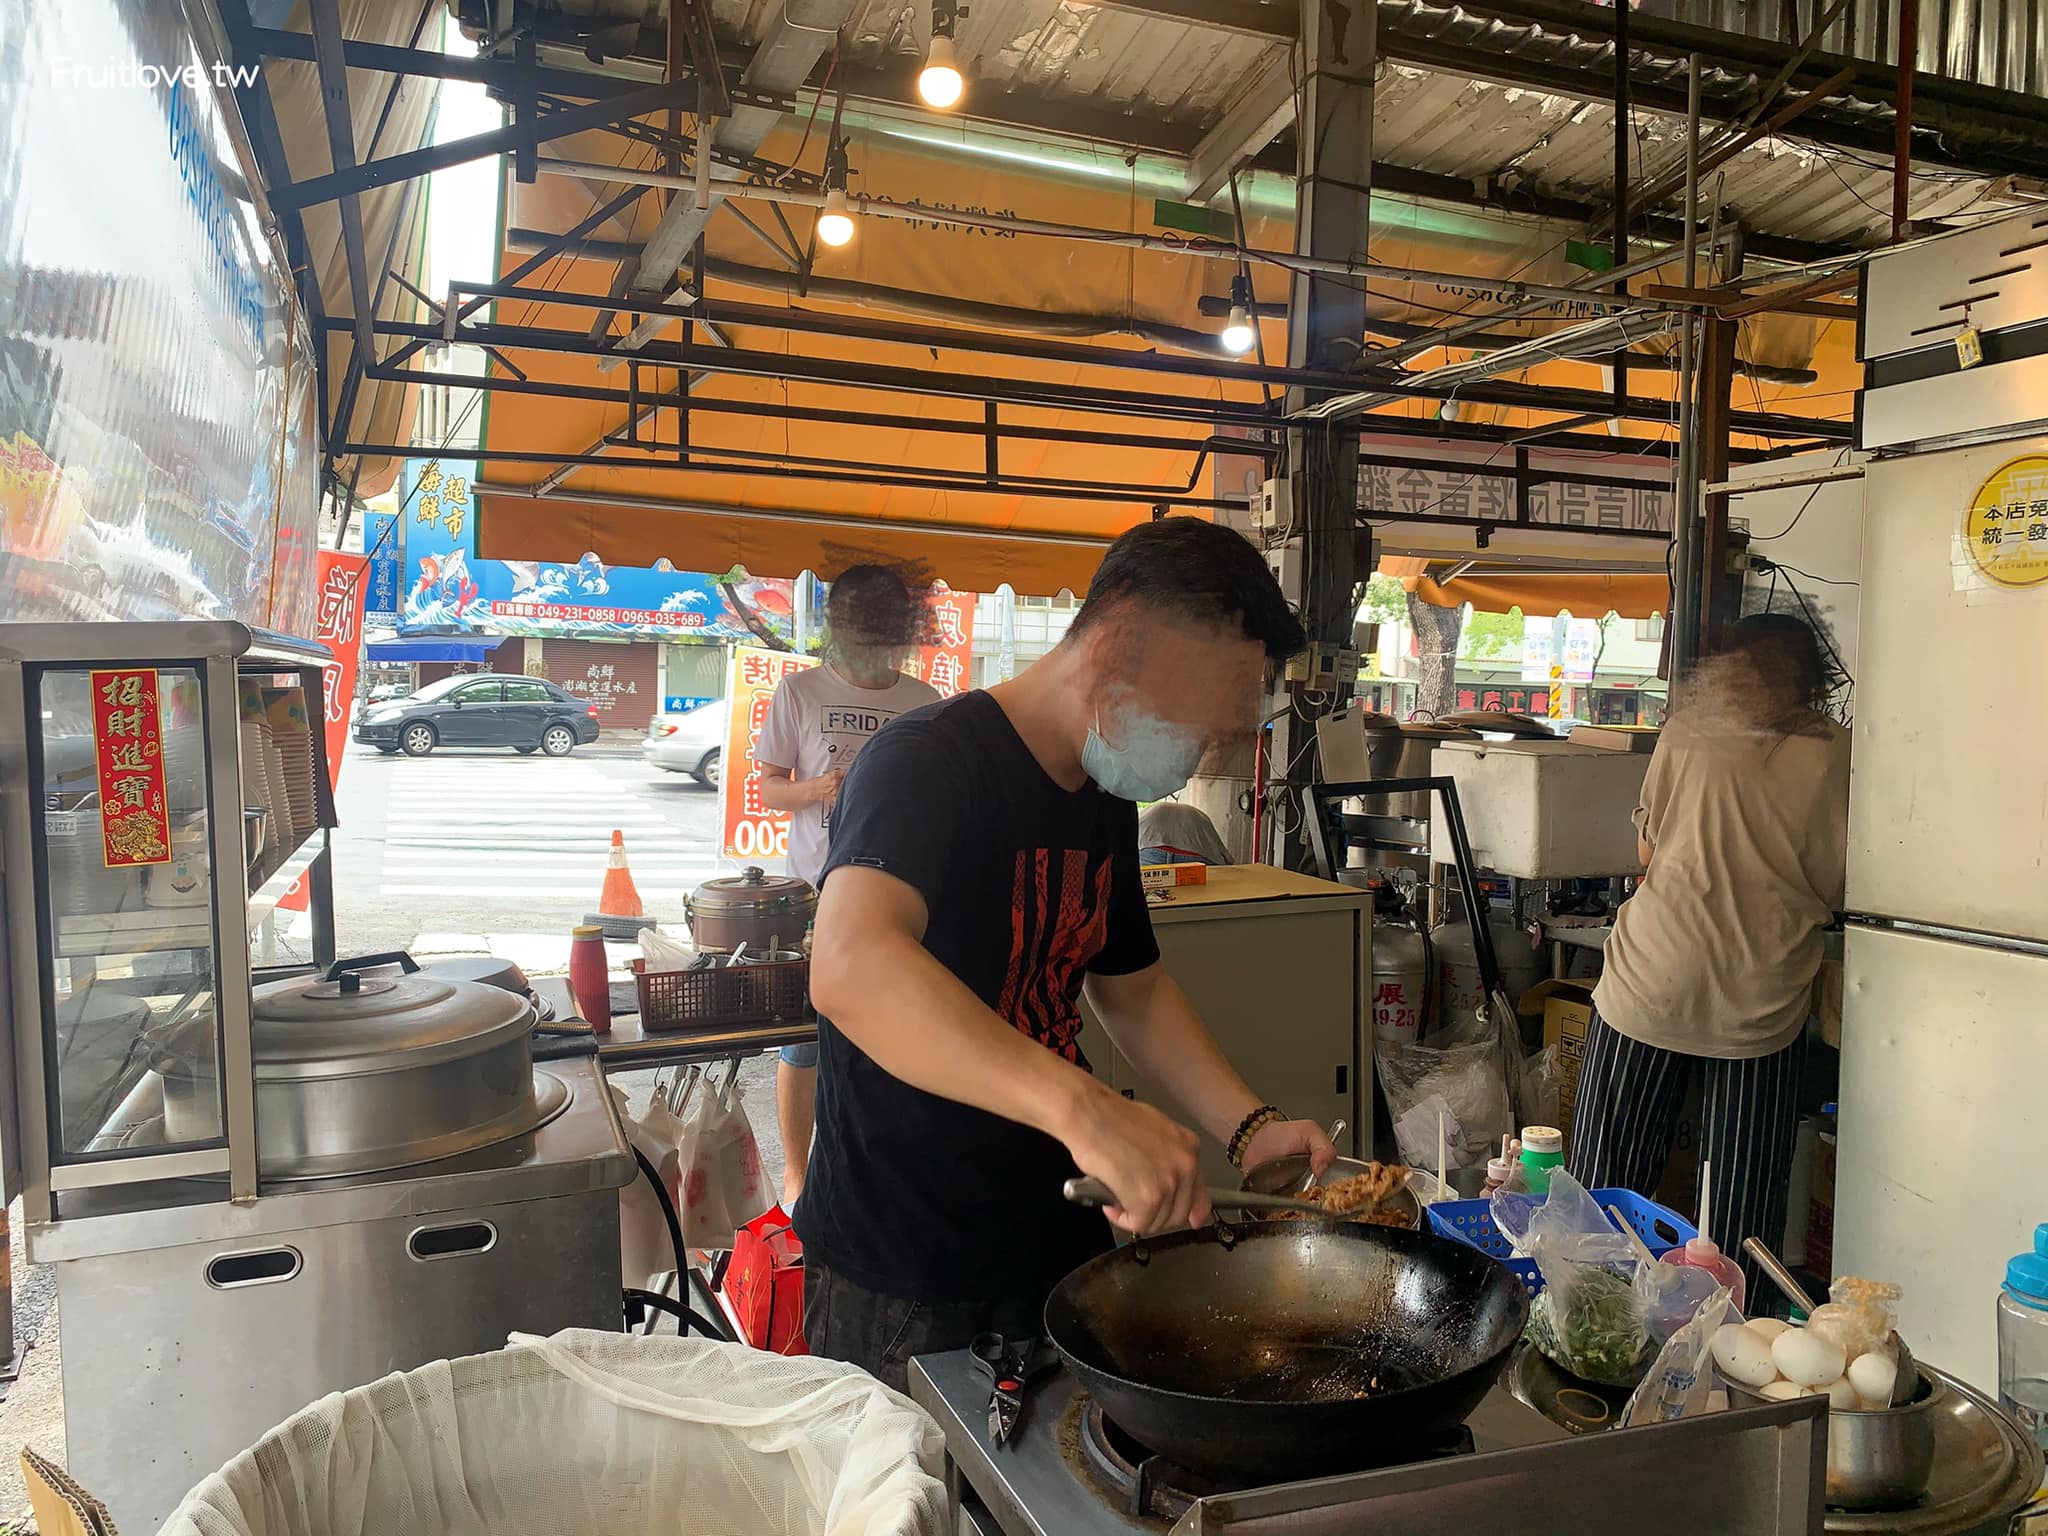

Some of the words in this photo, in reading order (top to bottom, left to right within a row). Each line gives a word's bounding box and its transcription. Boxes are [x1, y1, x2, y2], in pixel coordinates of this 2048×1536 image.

[416, 462, 444, 530] 海鮮
[443, 475, 468, 541] 超市
[537, 605, 616, 621] 049-231-0858
[622, 611, 702, 626] 0965-035-689
[101, 675, 153, 809] 招財進寶
